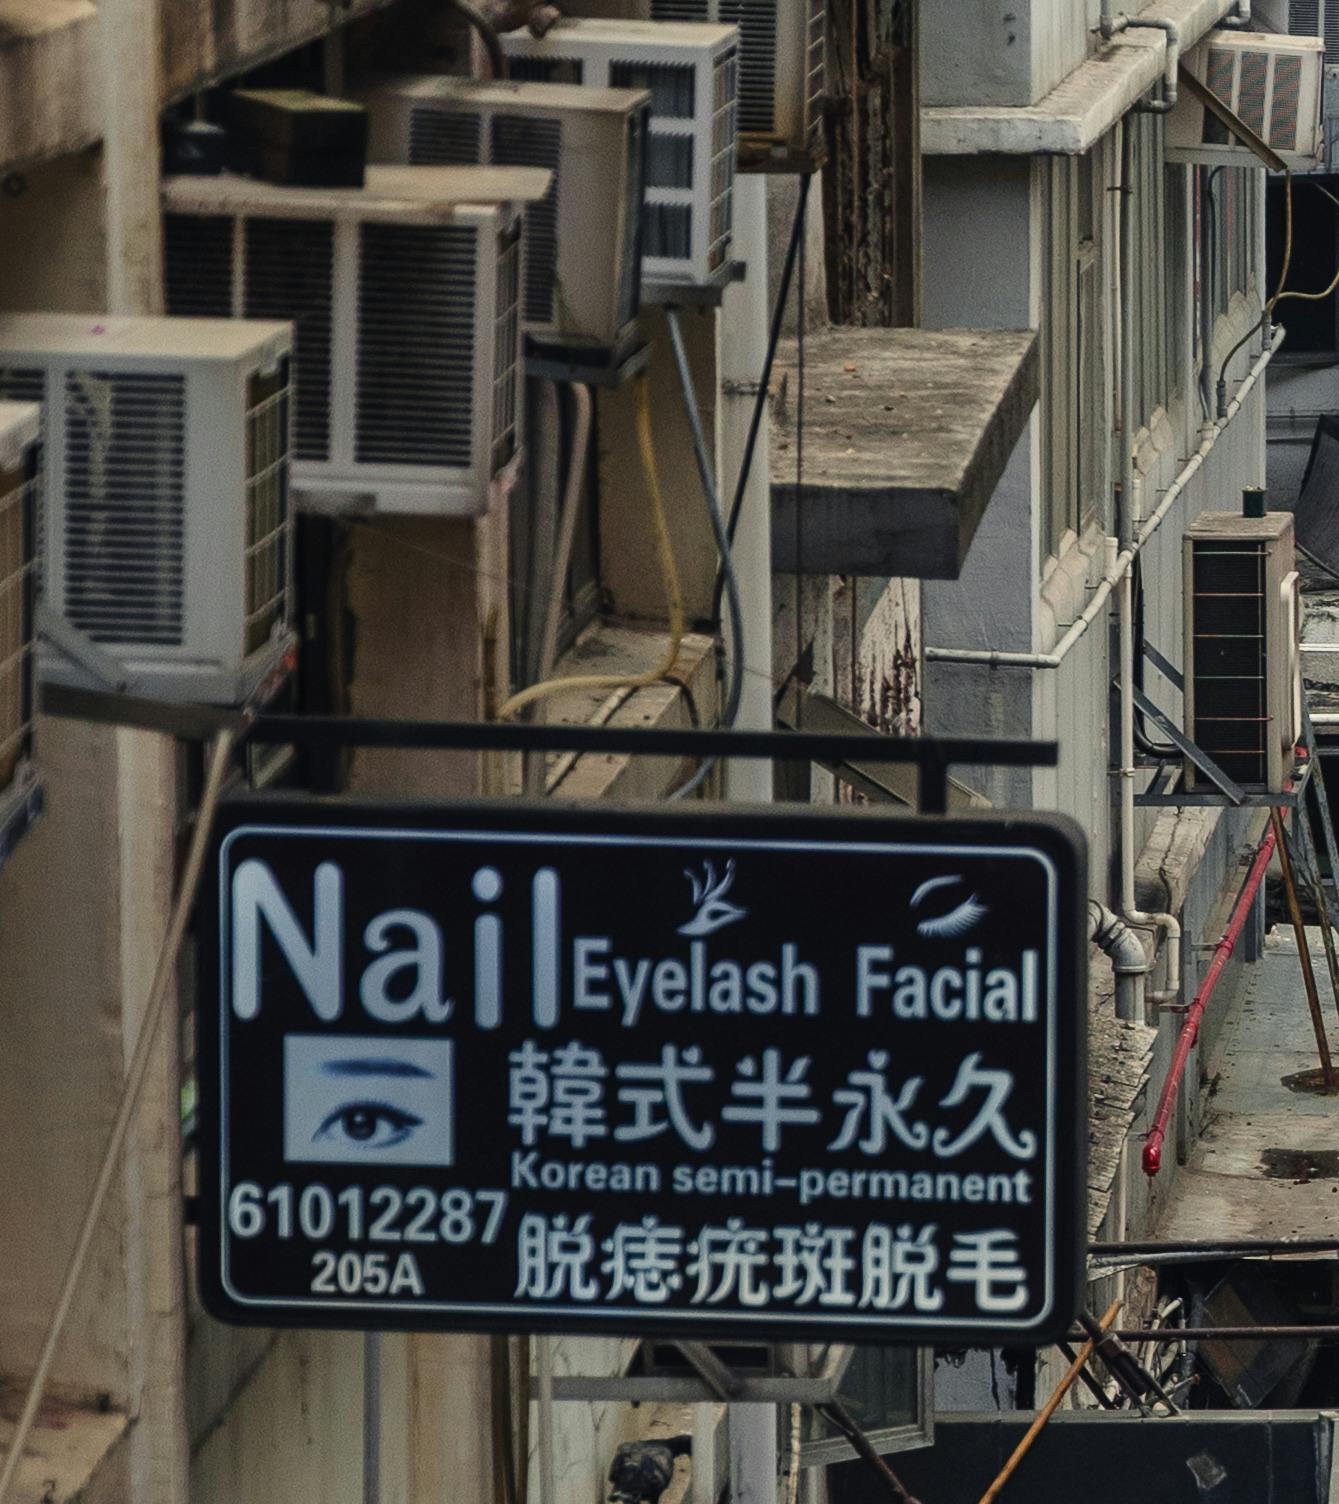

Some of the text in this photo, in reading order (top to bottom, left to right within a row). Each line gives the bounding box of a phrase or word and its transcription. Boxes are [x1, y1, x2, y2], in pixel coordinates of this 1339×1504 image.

[230, 858, 1040, 1030] Nail Eyelash Facial
[508, 1039, 1038, 1160] 韓式半永久
[510, 1152, 661, 1194] Korean
[228, 1182, 509, 1245] 61012287
[310, 1250, 425, 1296] 205A
